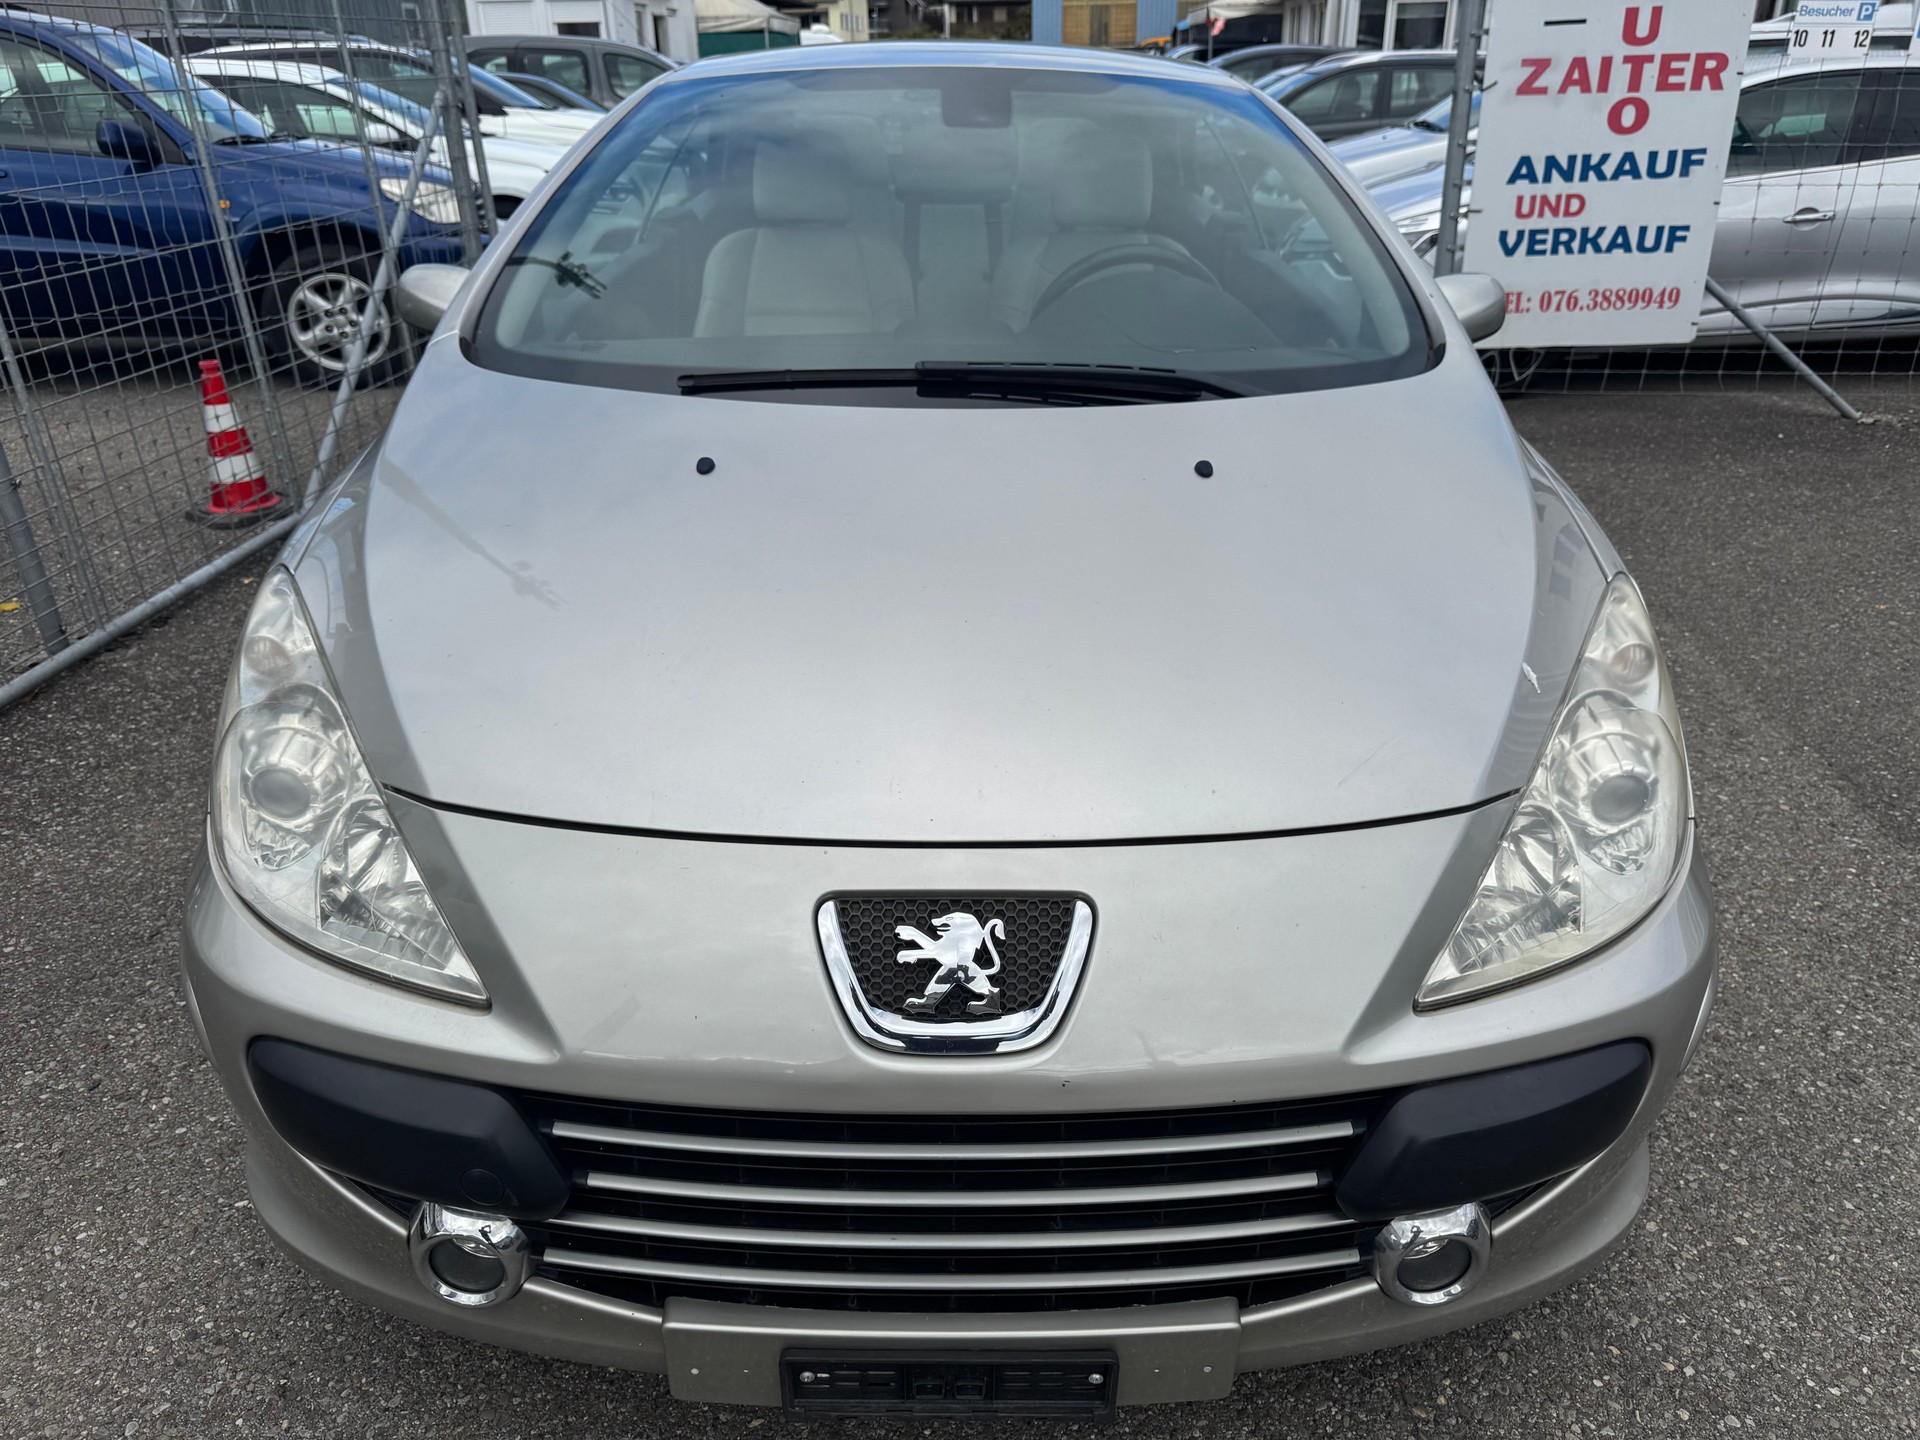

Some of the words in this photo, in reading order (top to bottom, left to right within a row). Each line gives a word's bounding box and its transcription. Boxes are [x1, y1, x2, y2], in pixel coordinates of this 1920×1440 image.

[1799, 5, 1854, 17] Besucher
[1793, 29, 1809, 48] 10
[1821, 29, 1836, 48] 11
[1853, 29, 1870, 49] 12
[1515, 52, 1730, 96] ZAITER
[1506, 148, 1708, 186] ANKAUF
[1514, 193, 1586, 220] UND
[1498, 225, 1691, 258] VERKAUF
[1505, 291, 1532, 315] EL:
[1538, 286, 1681, 313] 076.3889949
